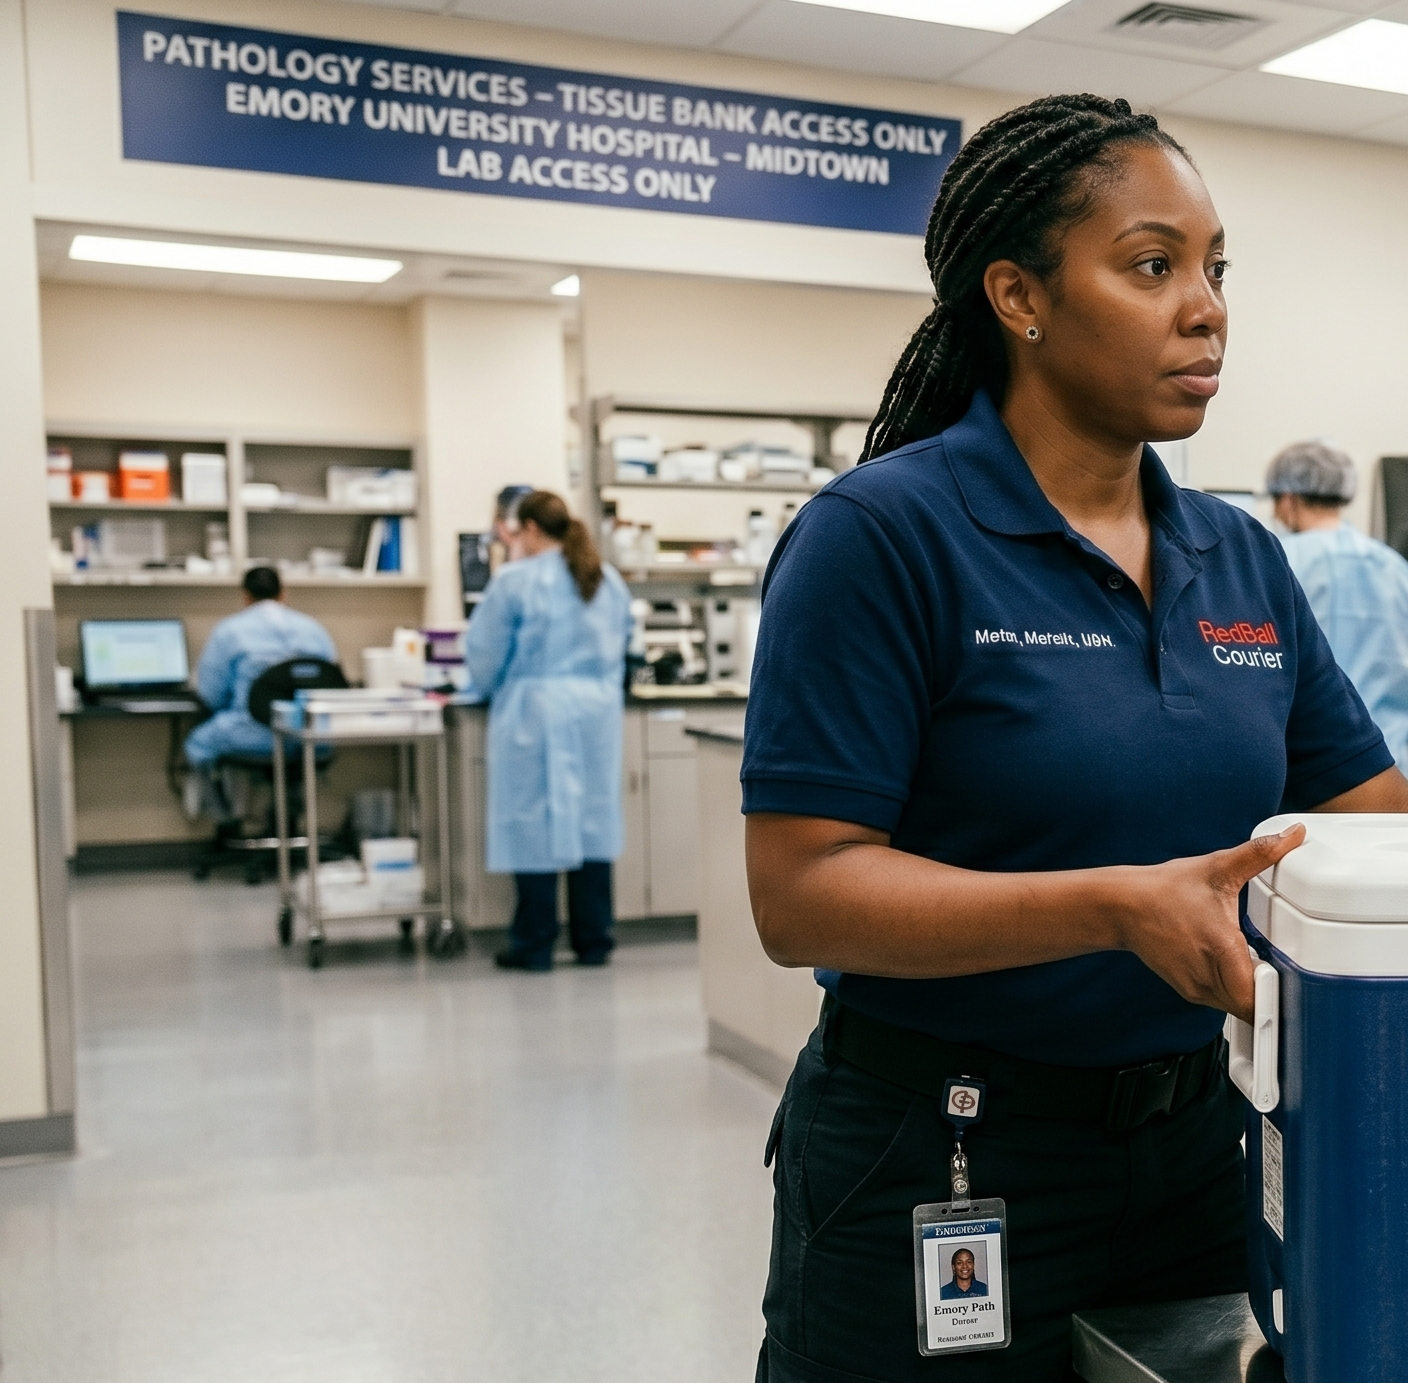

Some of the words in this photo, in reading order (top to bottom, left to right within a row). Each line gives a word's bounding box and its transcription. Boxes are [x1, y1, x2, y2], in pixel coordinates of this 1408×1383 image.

[143, 31, 364, 86] PATHOLOGY
[371, 60, 528, 107] SERVICES
[556, 82, 666, 123] TISSUE
[673, 97, 757, 135] BANK
[761, 109, 870, 146] ACCESS
[873, 121, 948, 156] ONLY
[226, 82, 356, 126] EMORY
[363, 100, 560, 148] UNIVERSITY
[567, 122, 719, 167] HOSPITAL
[746, 143, 890, 186] MIDTOWN
[437, 146, 502, 181] LAB
[509, 156, 629, 195] ACCESS
[635, 168, 717, 202] ONLY
[1198, 620, 1279, 644] RedBall
[1212, 645, 1283, 669] Courier
[934, 1304, 969, 1316] Emory
[971, 1301, 995, 1312] Path
